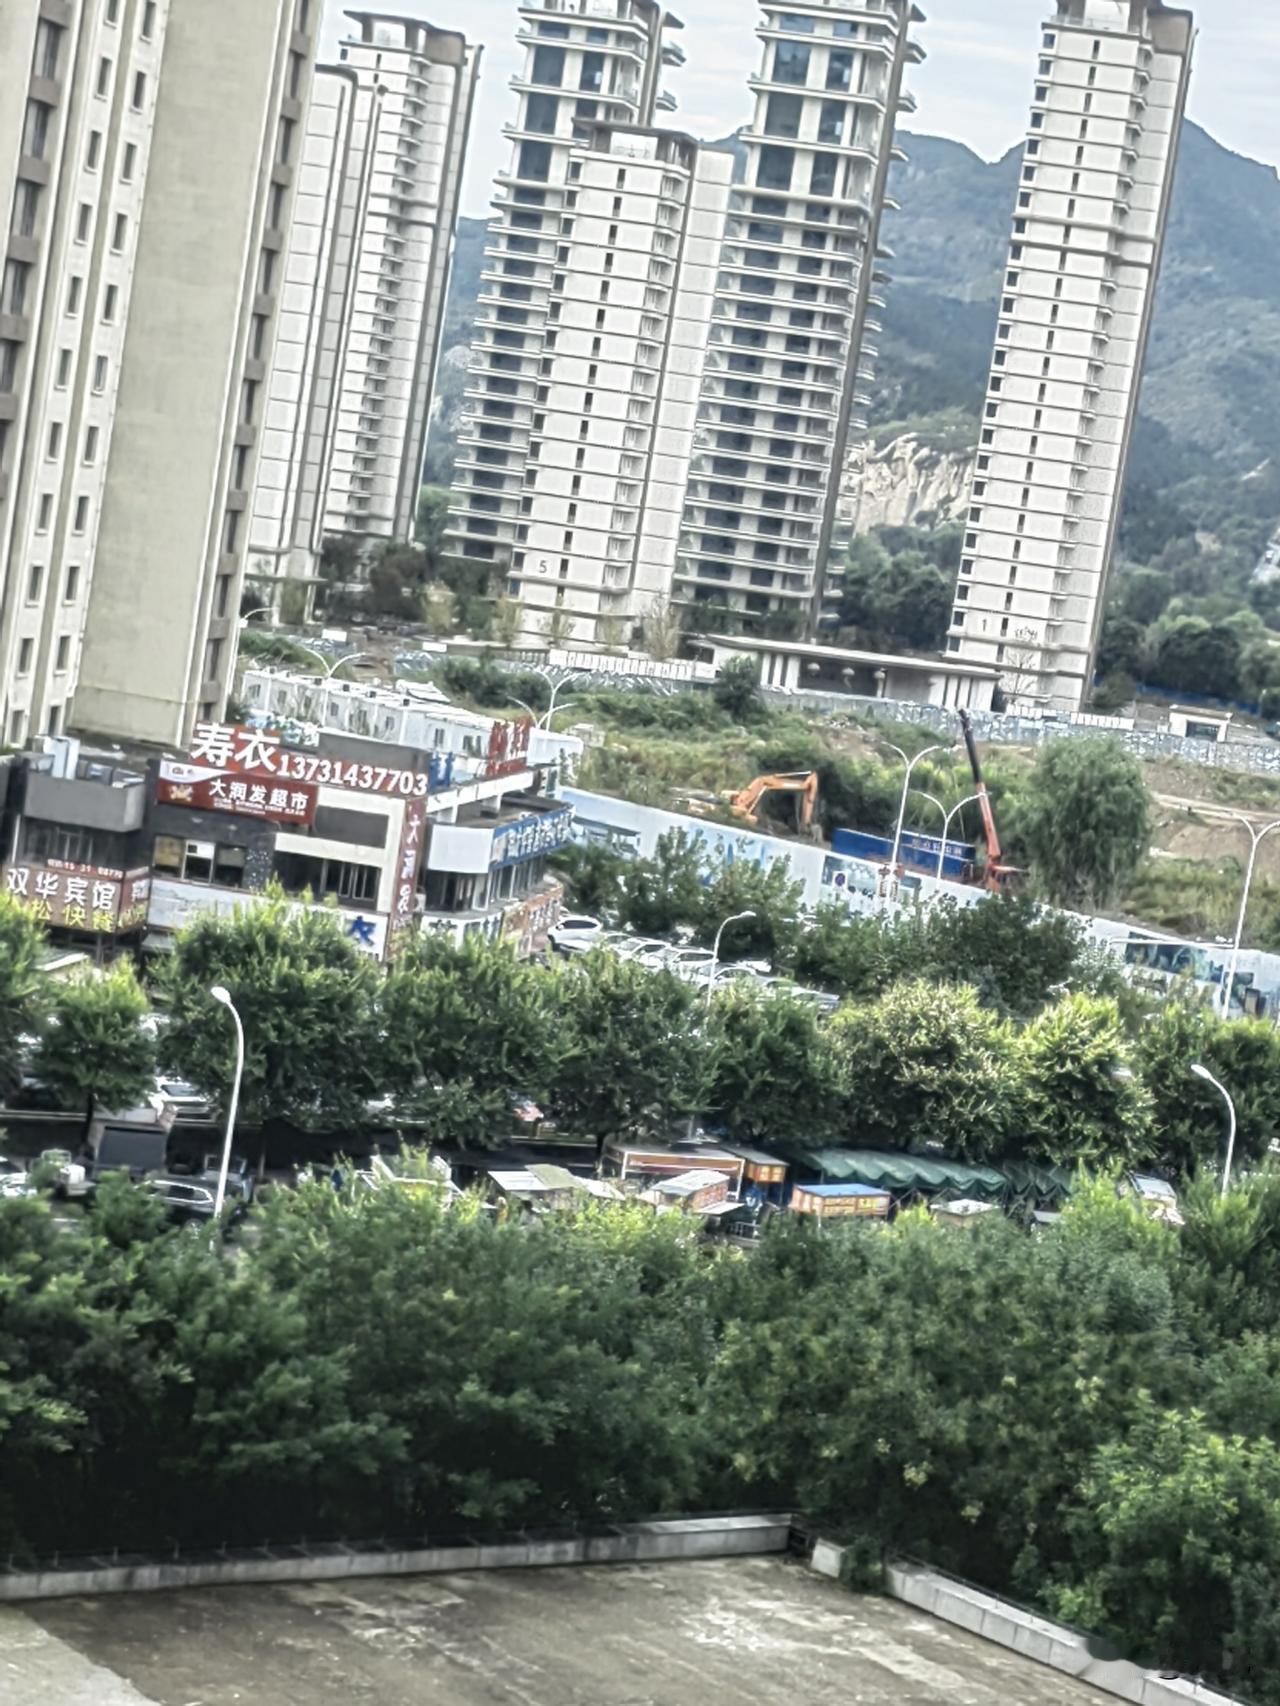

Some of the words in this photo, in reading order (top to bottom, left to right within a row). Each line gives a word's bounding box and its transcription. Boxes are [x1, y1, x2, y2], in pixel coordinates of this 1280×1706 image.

[538, 560, 547, 573] 5
[191, 723, 280, 772] 寿衣
[208, 778, 308, 810] 大润发超市
[276, 754, 428, 796] 13731437703
[7, 867, 116, 910] 双华宾馆
